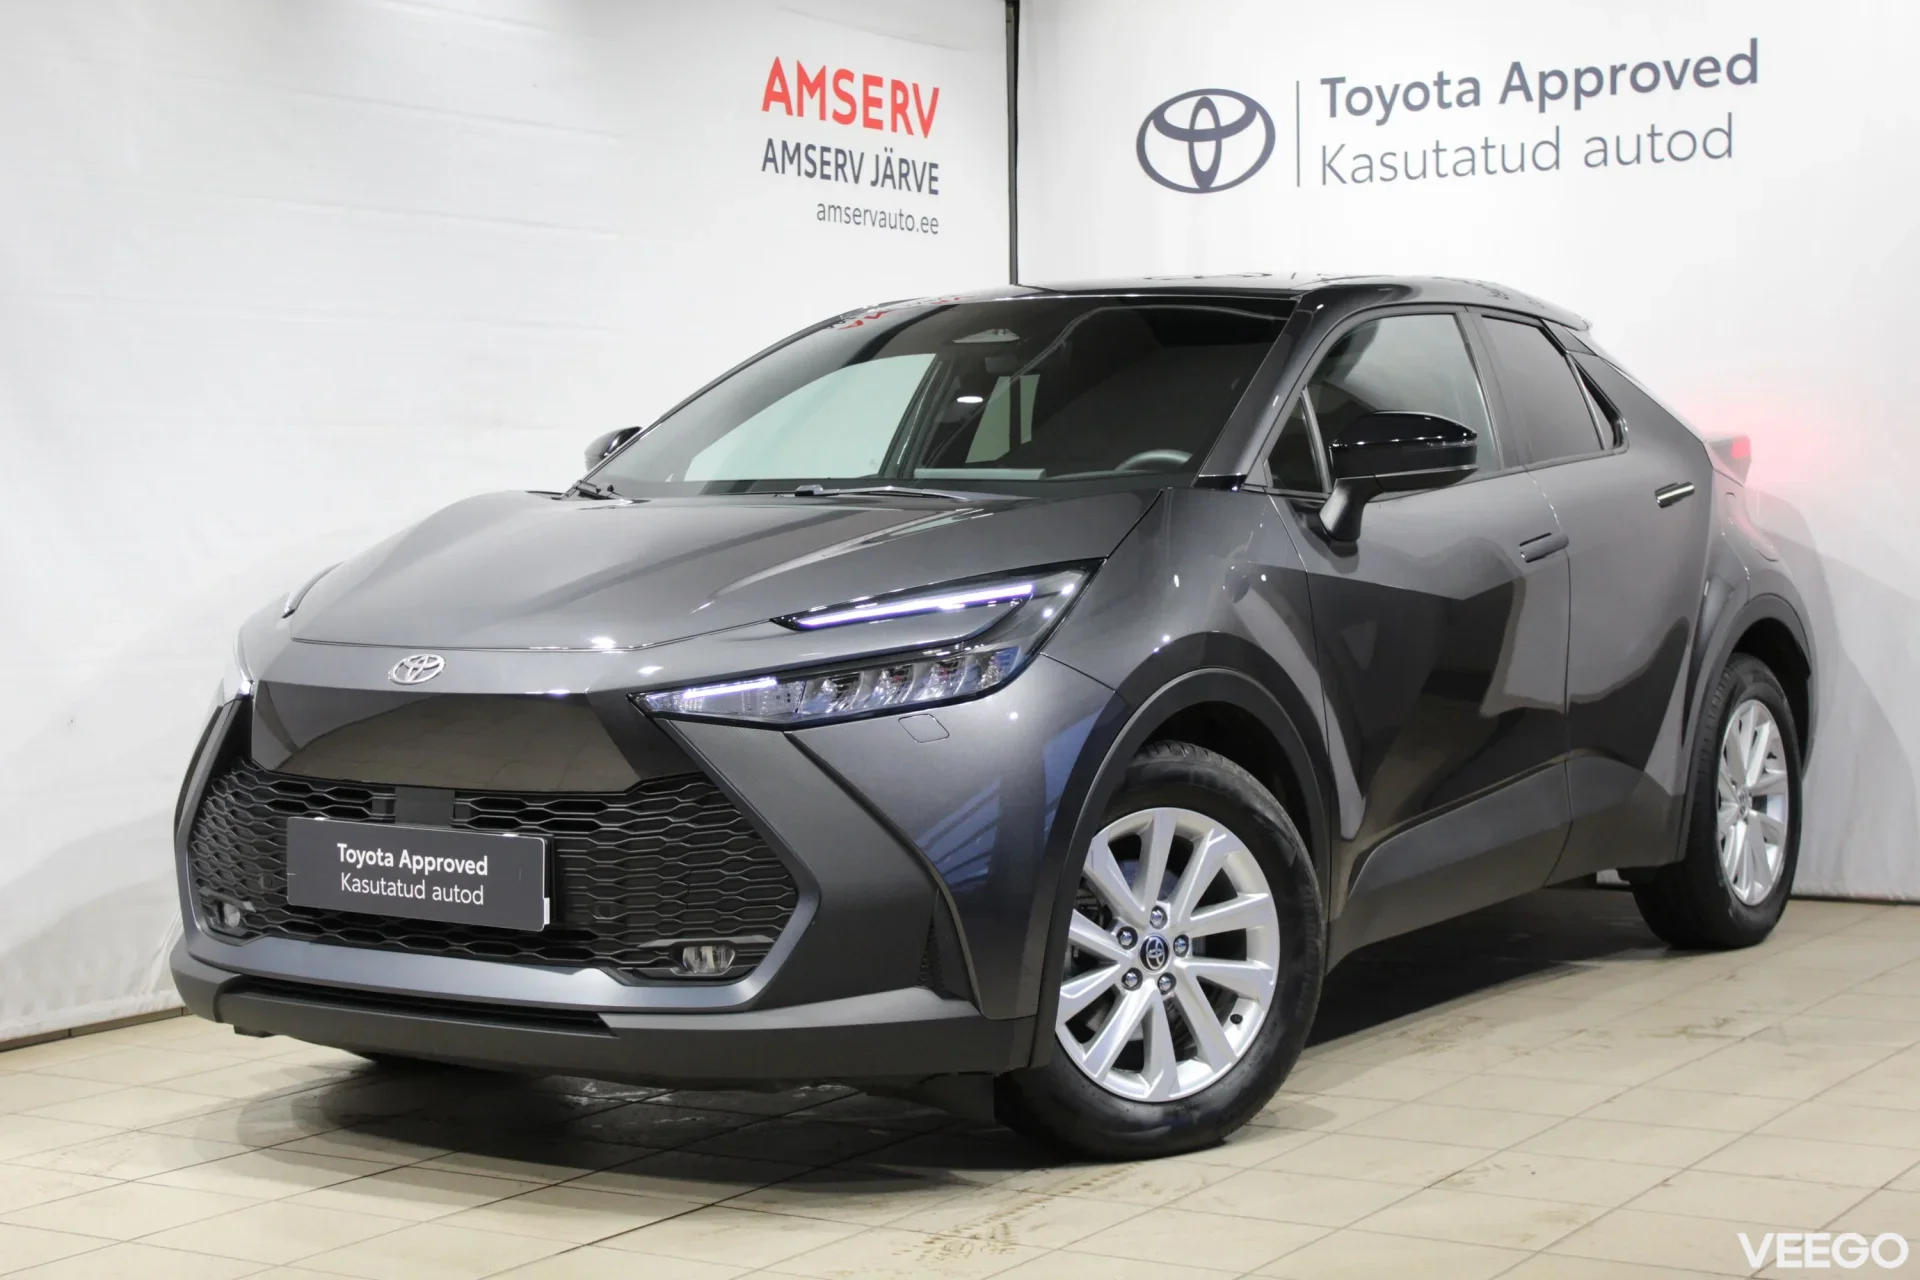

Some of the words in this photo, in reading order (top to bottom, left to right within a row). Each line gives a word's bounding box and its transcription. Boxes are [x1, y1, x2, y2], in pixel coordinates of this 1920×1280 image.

[761, 55, 940, 139] AMSERV
[1320, 70, 1482, 127] Toyota
[1499, 37, 1759, 114] Approved
[761, 137, 865, 185] AMSERV
[870, 146, 940, 196] JÄRVE
[1321, 125, 1561, 186] Kasutatud
[1583, 111, 1734, 168] autod
[816, 202, 940, 236] amservauto.ee
[336, 842, 394, 869] Toyota
[398, 848, 489, 876] Approved
[341, 871, 426, 900] Kasutatud
[431, 884, 485, 905] autod
